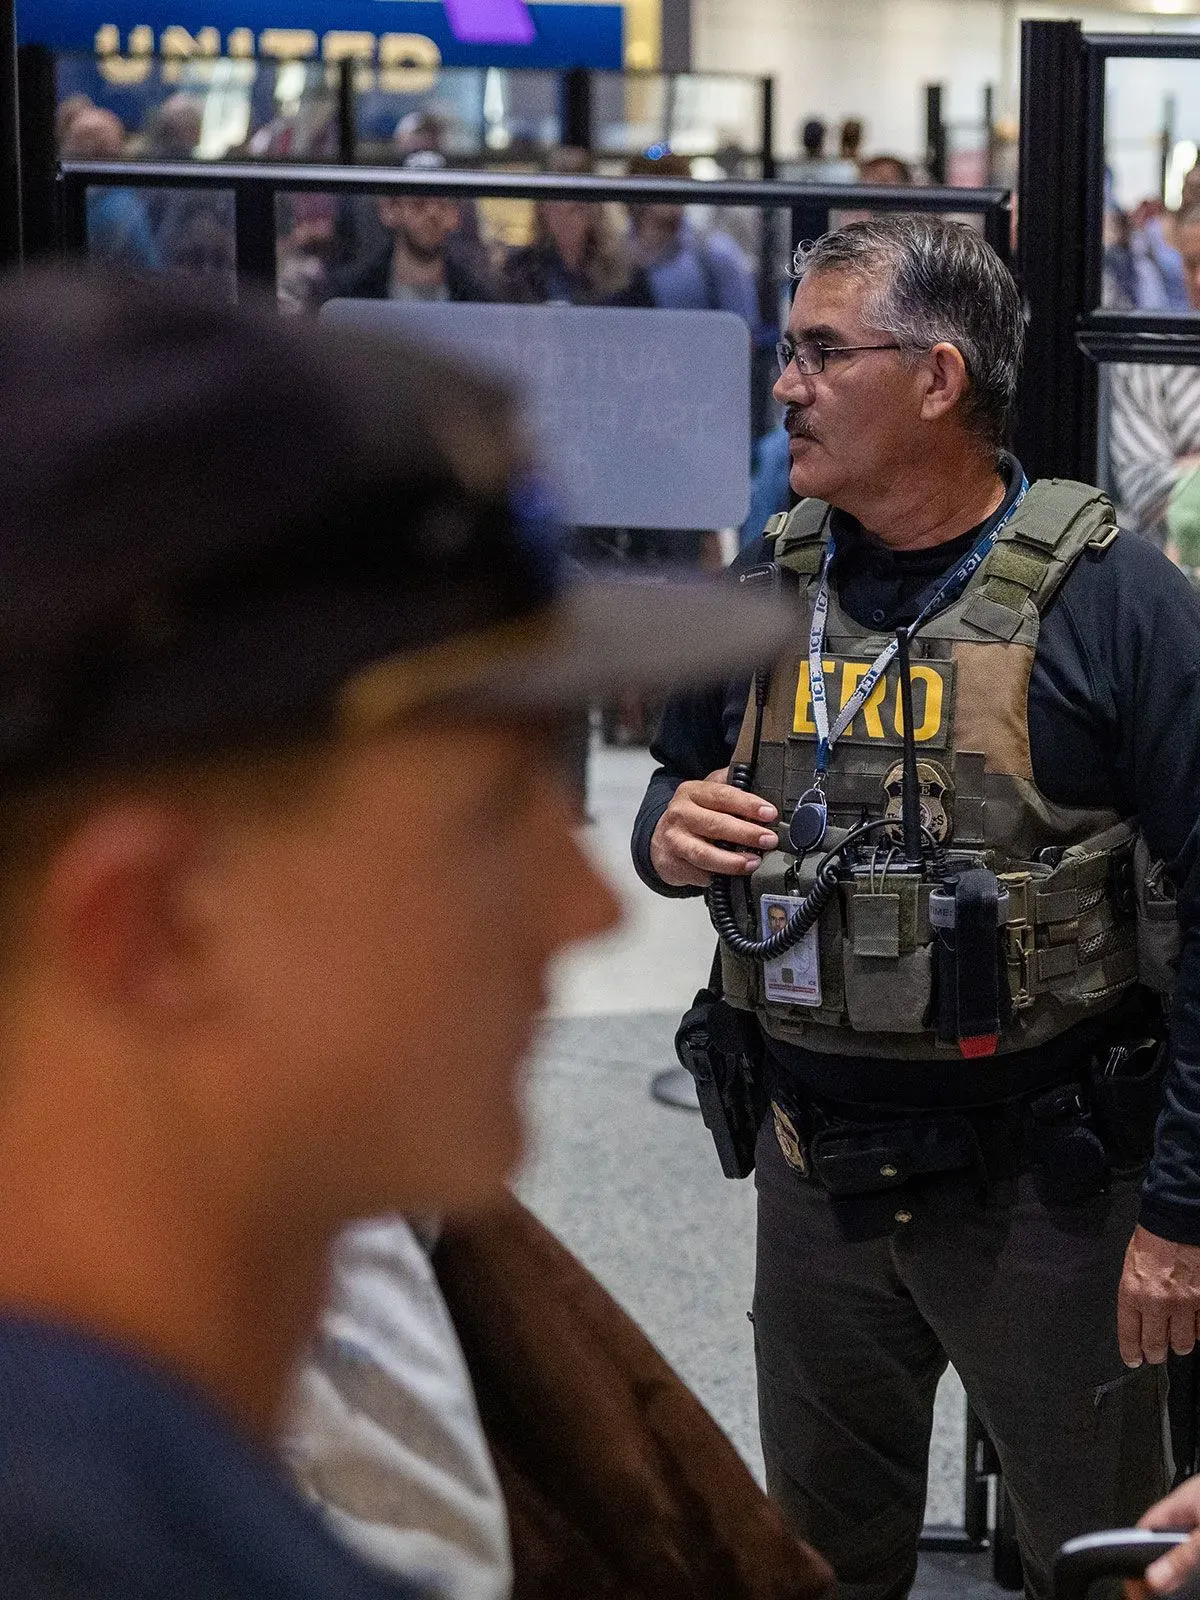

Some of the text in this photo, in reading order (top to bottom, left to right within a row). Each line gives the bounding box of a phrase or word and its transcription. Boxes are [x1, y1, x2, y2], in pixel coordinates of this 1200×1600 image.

[957, 553, 982, 582] ICE
[810, 627, 822, 653] ICE
[793, 660, 944, 742] ERO
[811, 671, 826, 702] ICE
